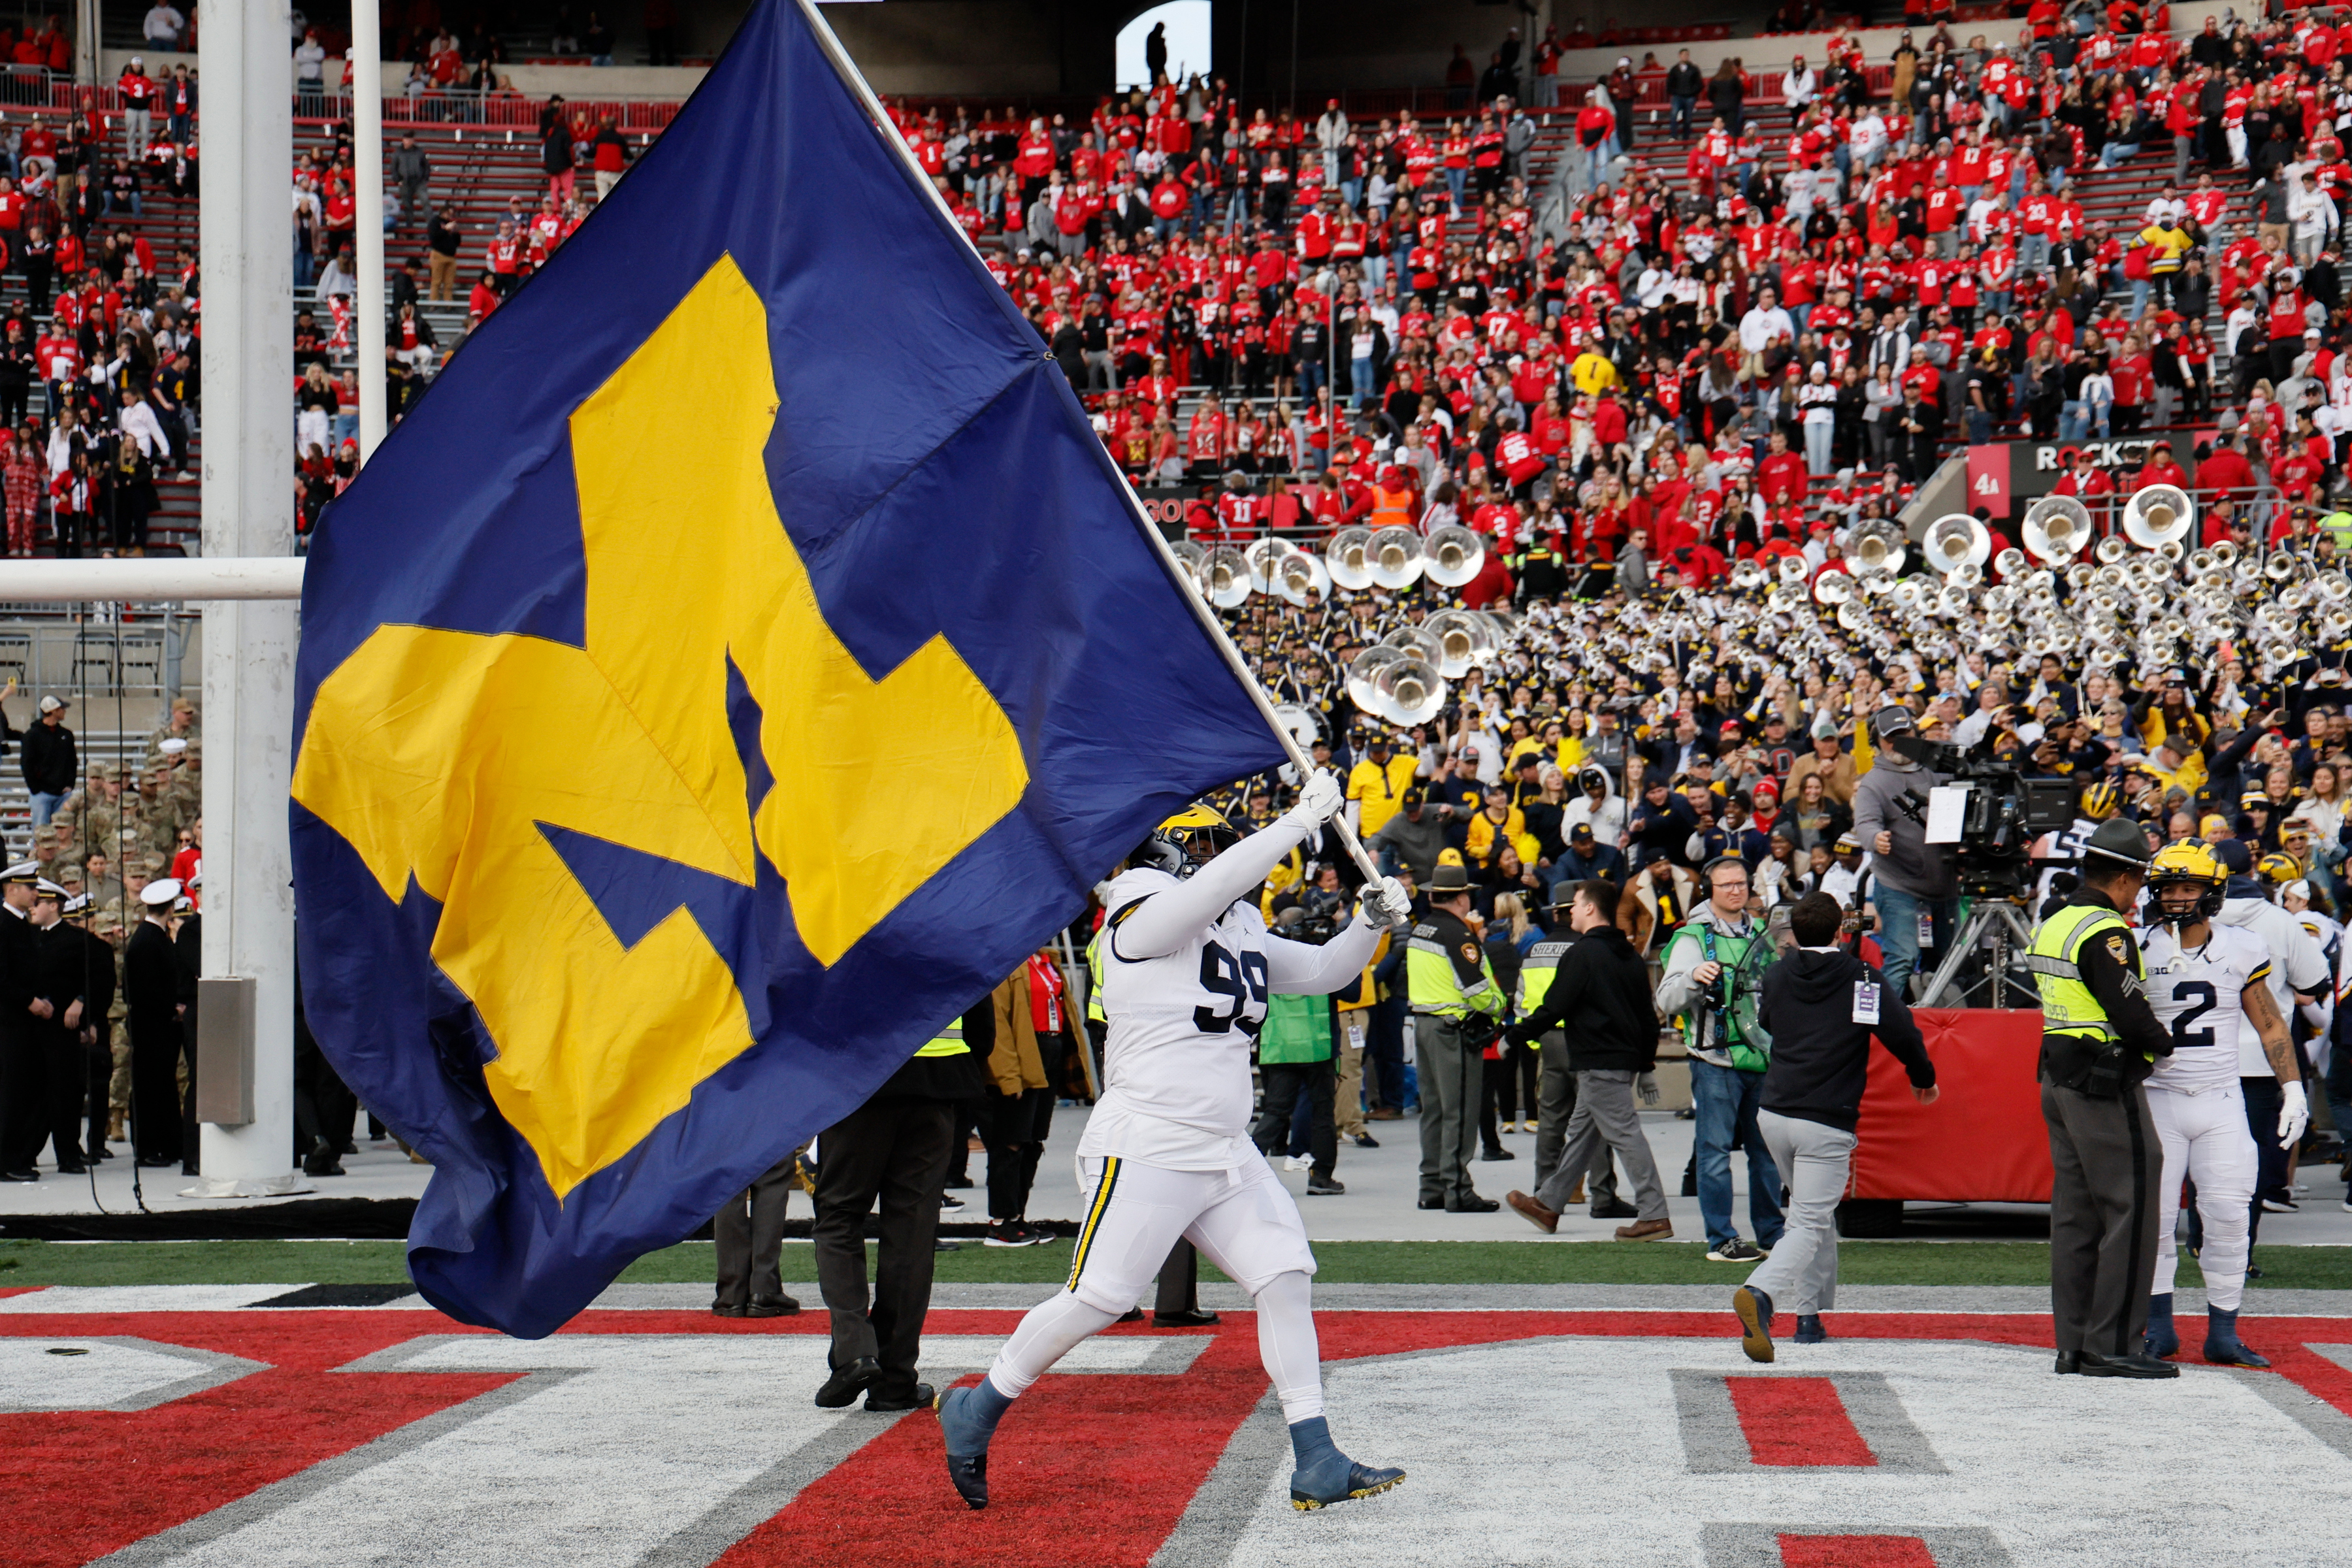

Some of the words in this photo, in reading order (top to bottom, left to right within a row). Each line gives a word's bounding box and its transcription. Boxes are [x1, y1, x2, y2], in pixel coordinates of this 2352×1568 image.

[134, 84, 143, 97] 3
[2014, 80, 2023, 97] 1
[927, 146, 936, 163] 1
[1930, 192, 1947, 208] 17
[2195, 201, 2209, 220] 7
[1753, 233, 1762, 251] 1
[1993, 255, 2002, 274] 1
[2062, 248, 2074, 267] 1
[1924, 269, 1936, 287] 0
[1489, 318, 1509, 346] 17
[1590, 362, 1597, 380] 1
[1504, 439, 1529, 464] 95
[1974, 473, 1999, 495] 4A
[1233, 502, 1252, 522] 11
[1698, 501, 1712, 522] 2
[1494, 516, 1507, 537] 2
[1531, 943, 1571, 956] SHERIF
[1193, 939, 1269, 1040] 99
[2172, 981, 2217, 1048] 2
